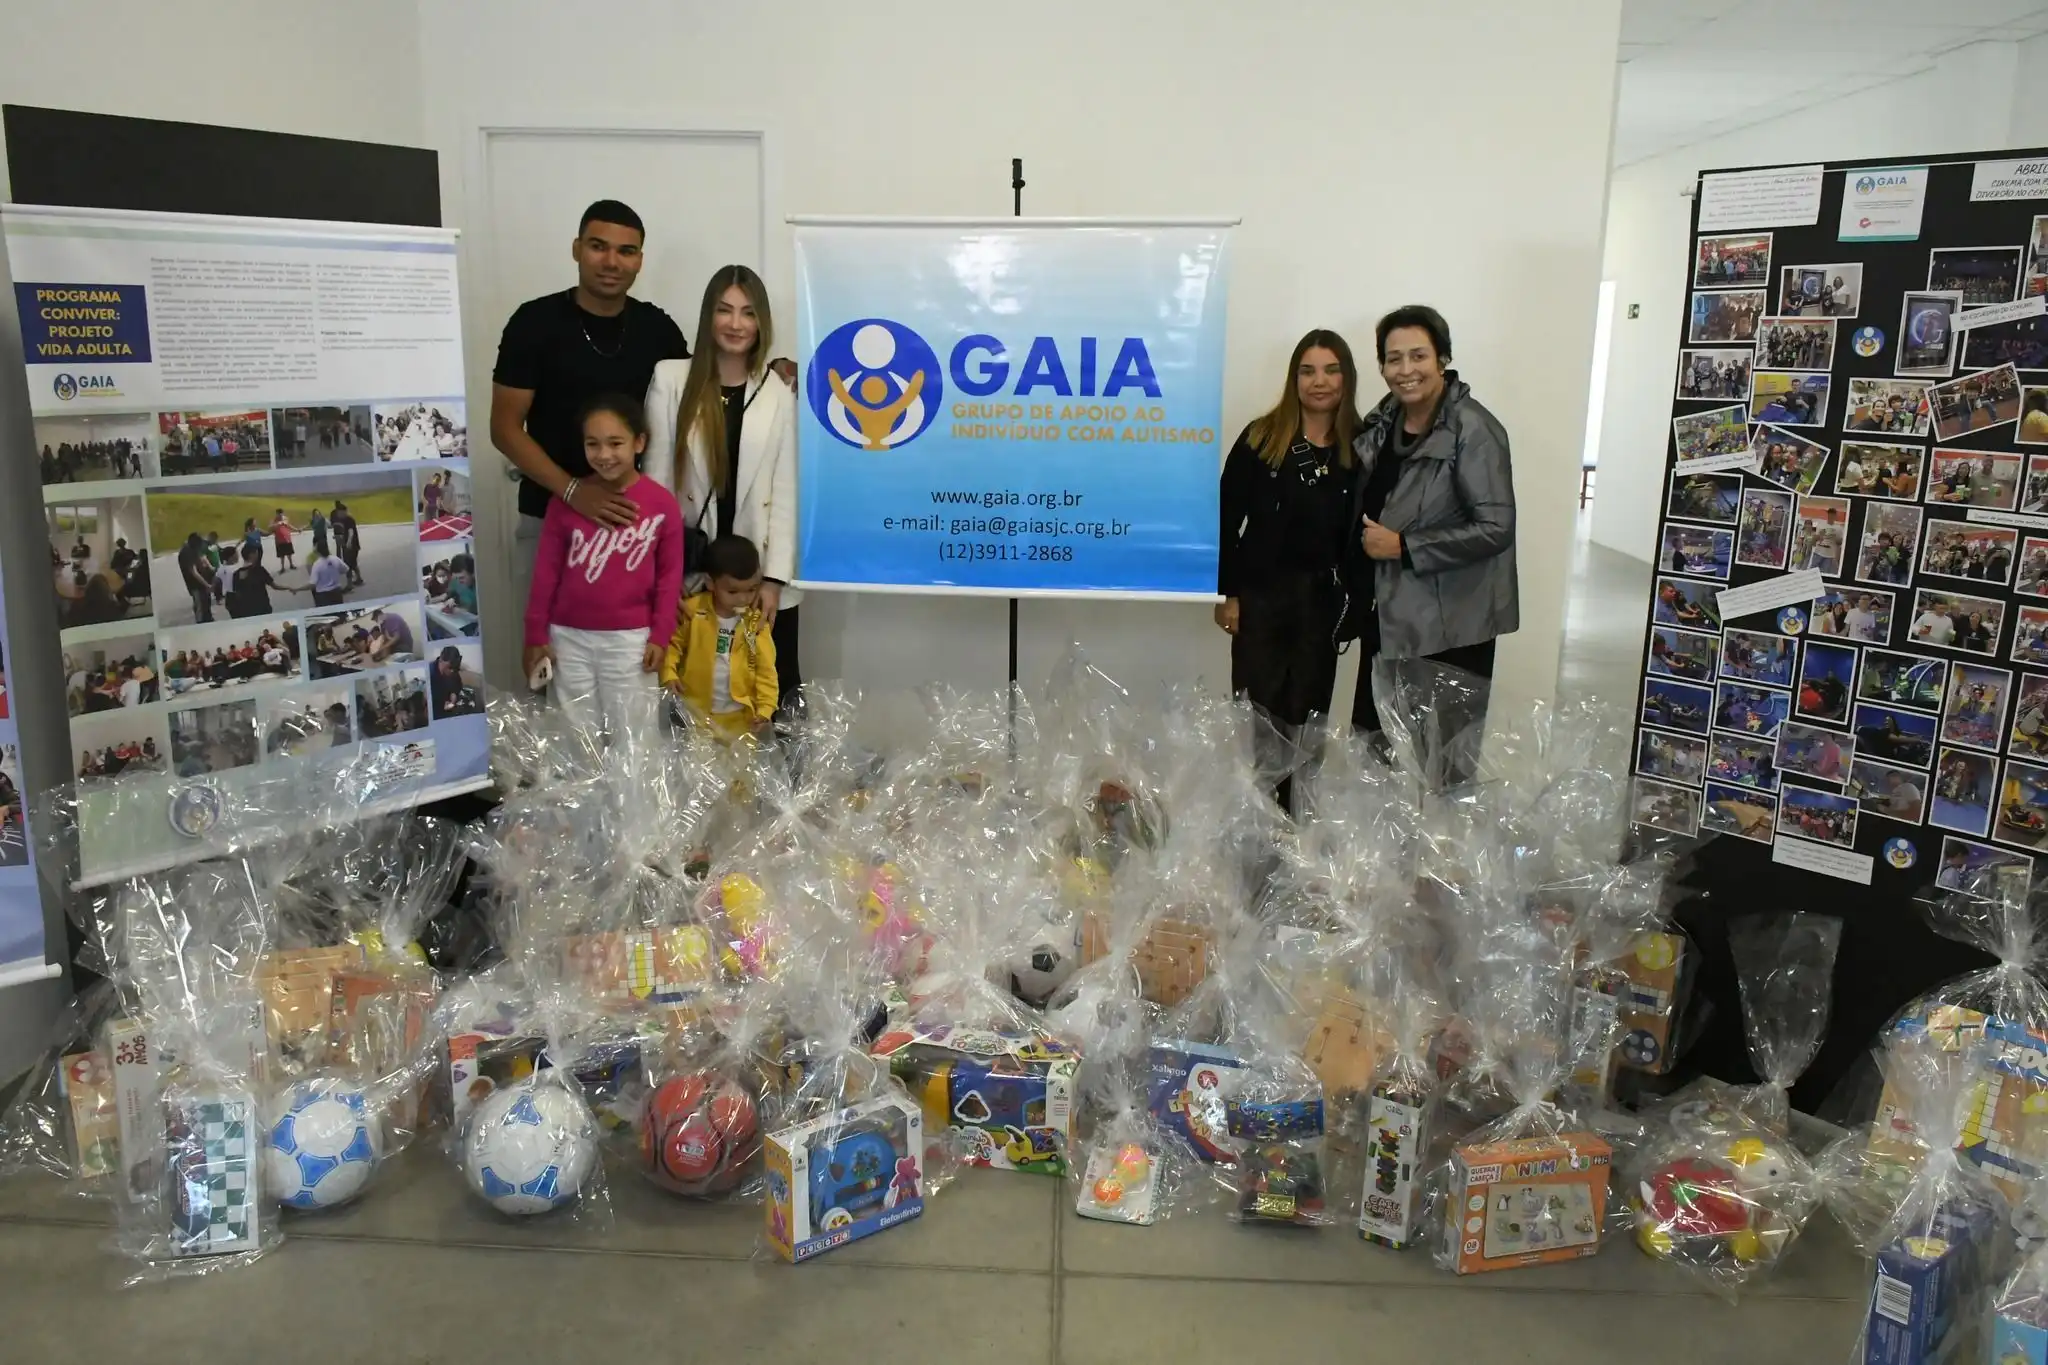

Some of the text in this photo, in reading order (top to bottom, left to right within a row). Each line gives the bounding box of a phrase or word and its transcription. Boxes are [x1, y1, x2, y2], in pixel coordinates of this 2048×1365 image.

[1877, 176, 1907, 186] GAIA
[36, 289, 121, 303] PROGRAMA
[40, 307, 120, 320] CONVIVER:
[48, 325, 114, 338] PROJETO
[36, 343, 132, 355] VIDA ADULTA
[949, 334, 1163, 398] GAIA
[78, 375, 115, 388] GAIA
[952, 403, 1165, 422] GRUPO DE APOIO AO
[952, 421, 1214, 444] INDIVÍDUO COM AUTISMO
[931, 490, 1083, 510] www.gaia.org.br
[883, 515, 1132, 538] e-mail: gaia@gaiasjc.org.br
[939, 542, 1073, 563] (12)3911-2868
[1503, 1155, 1590, 1180] ANIMAS
